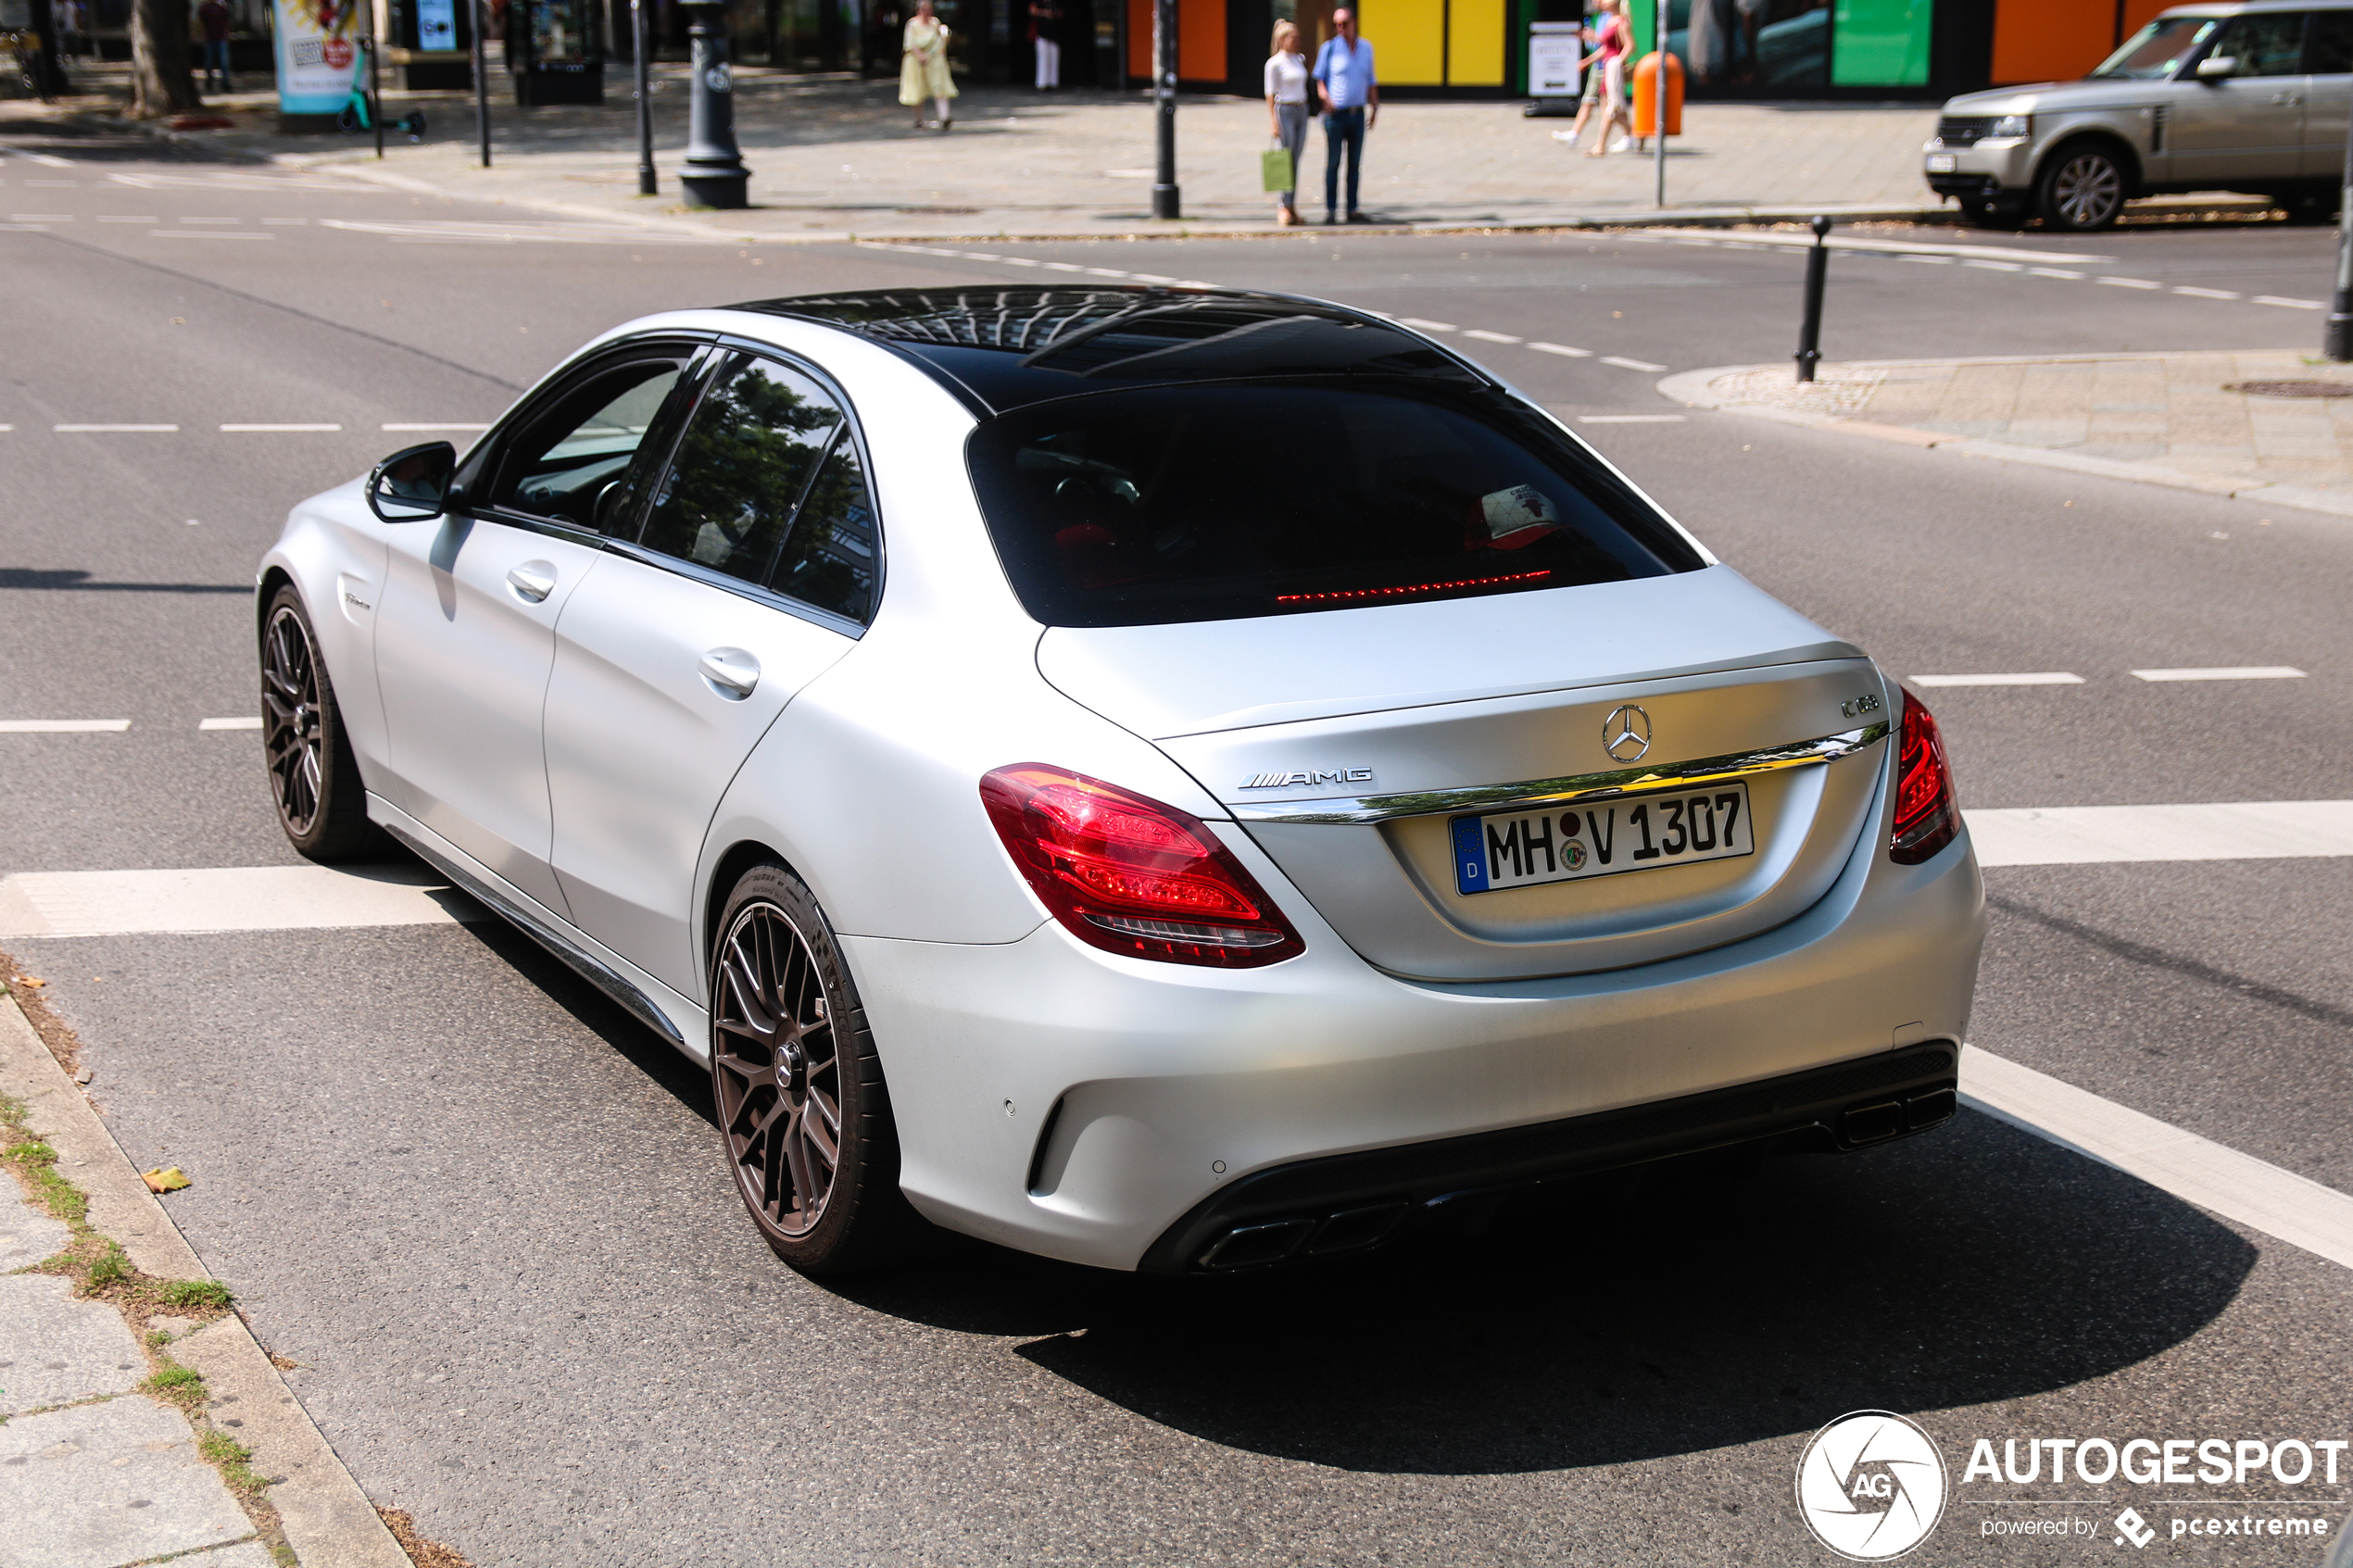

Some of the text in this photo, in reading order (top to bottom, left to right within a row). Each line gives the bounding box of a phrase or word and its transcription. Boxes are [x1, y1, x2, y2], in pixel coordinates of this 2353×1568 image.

[1841, 701, 1856, 718] C
[1278, 767, 1372, 786] AMG
[1486, 816, 1556, 880] MH
[1586, 808, 1615, 865] V
[1629, 792, 1741, 860] 1307
[1466, 862, 1478, 879] D
[832, 990, 858, 1102] MICHELIN
